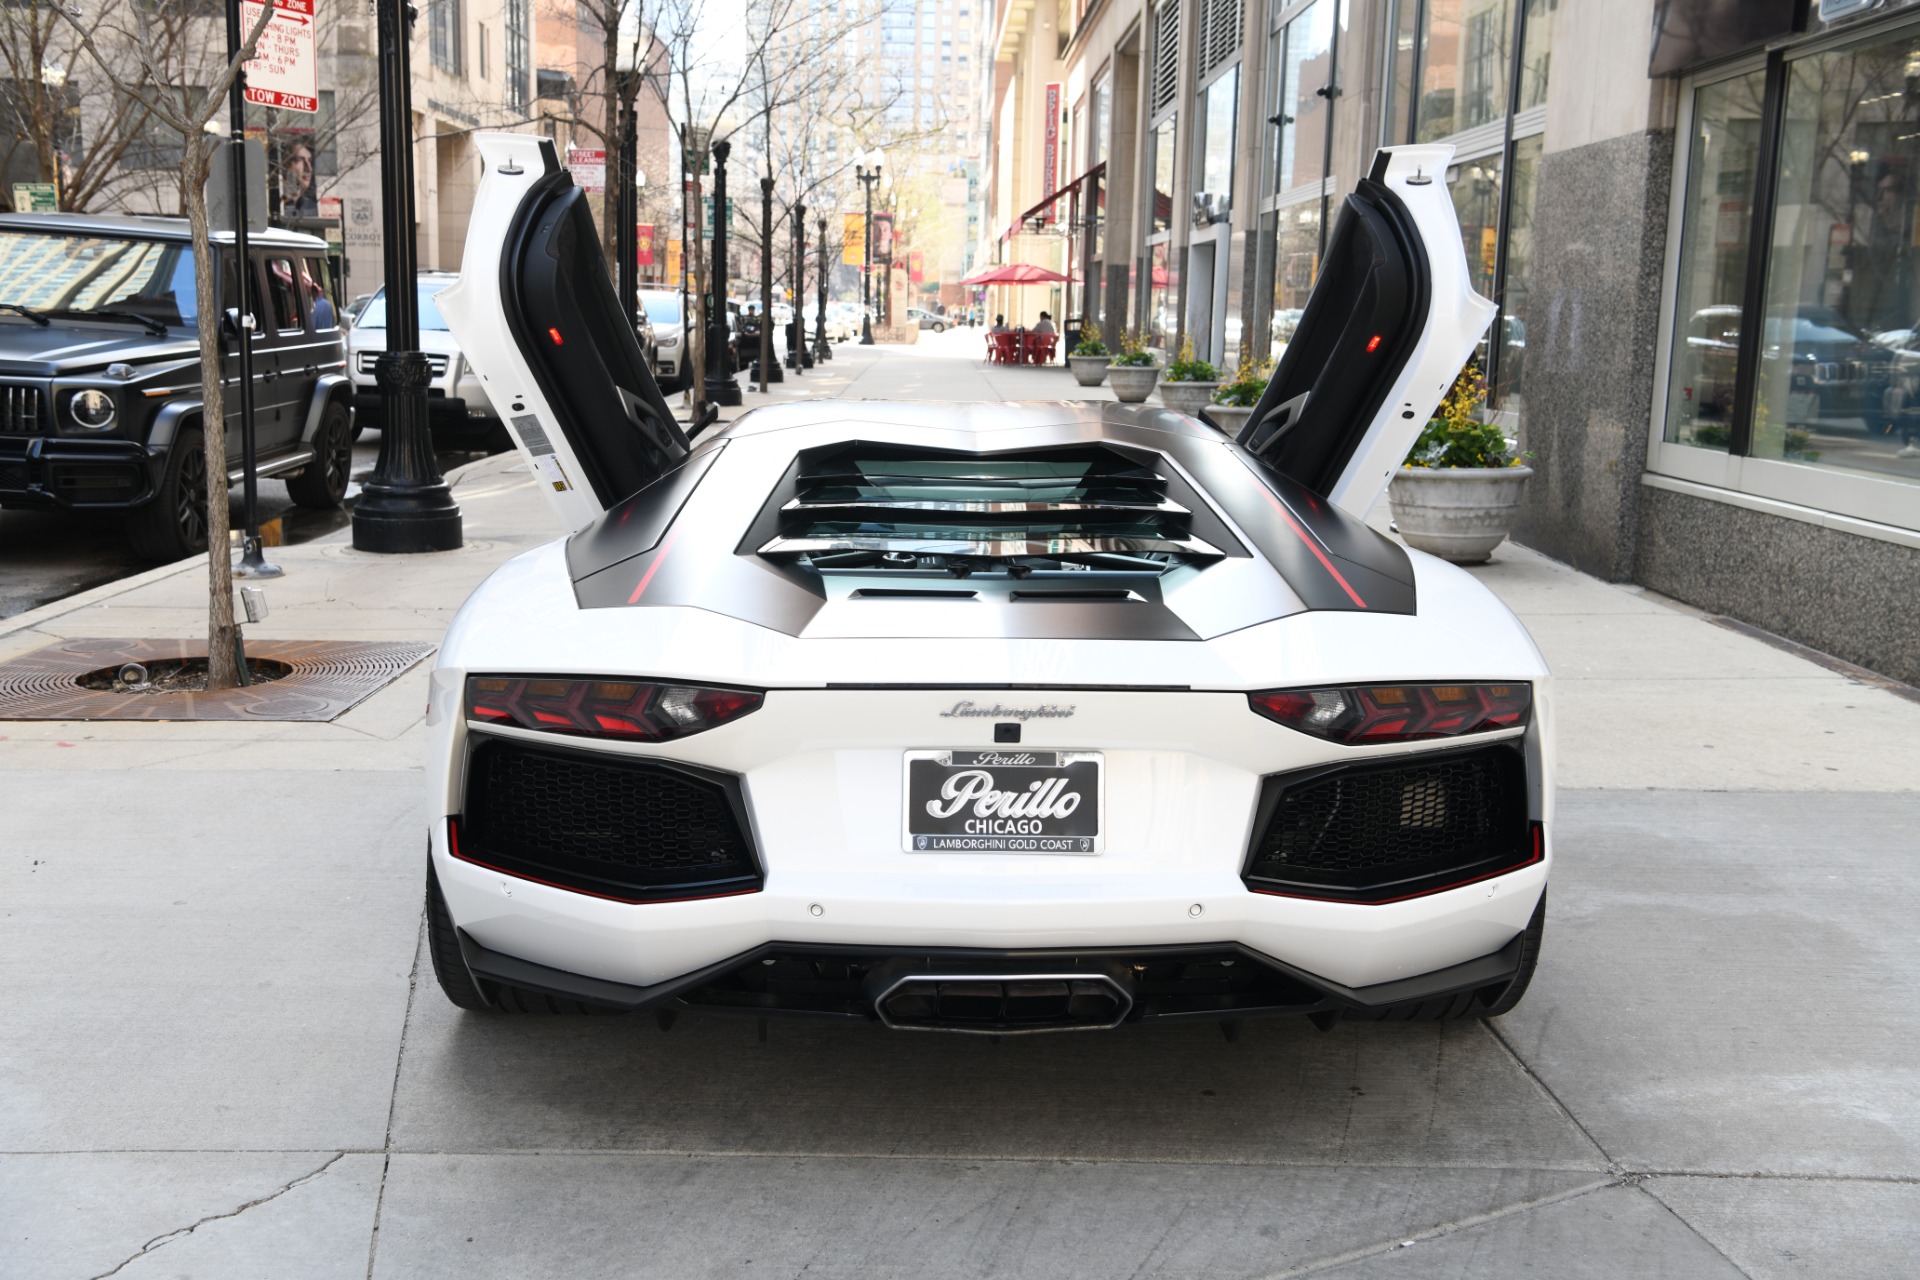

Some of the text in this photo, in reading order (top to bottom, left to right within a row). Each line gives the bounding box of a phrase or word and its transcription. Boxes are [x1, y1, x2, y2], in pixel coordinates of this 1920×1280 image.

[246, 7, 261, 17] USE
[287, 0, 307, 12] ZONE
[285, 26, 312, 39] LIGHTS
[284, 35, 296, 45] PM
[274, 43, 300, 57] THURS
[247, 60, 262, 70] FRI
[269, 64, 286, 75] SUN
[284, 57, 296, 67] PM
[250, 88, 312, 110] TOW ZONE
[939, 700, 1076, 721] Lamborghini
[972, 751, 1036, 766] Perillo
[925, 769, 1081, 819] Perillo
[964, 819, 1043, 834] CHICAGO
[933, 838, 1073, 850] LAMBORGHINI GOLD COAST
